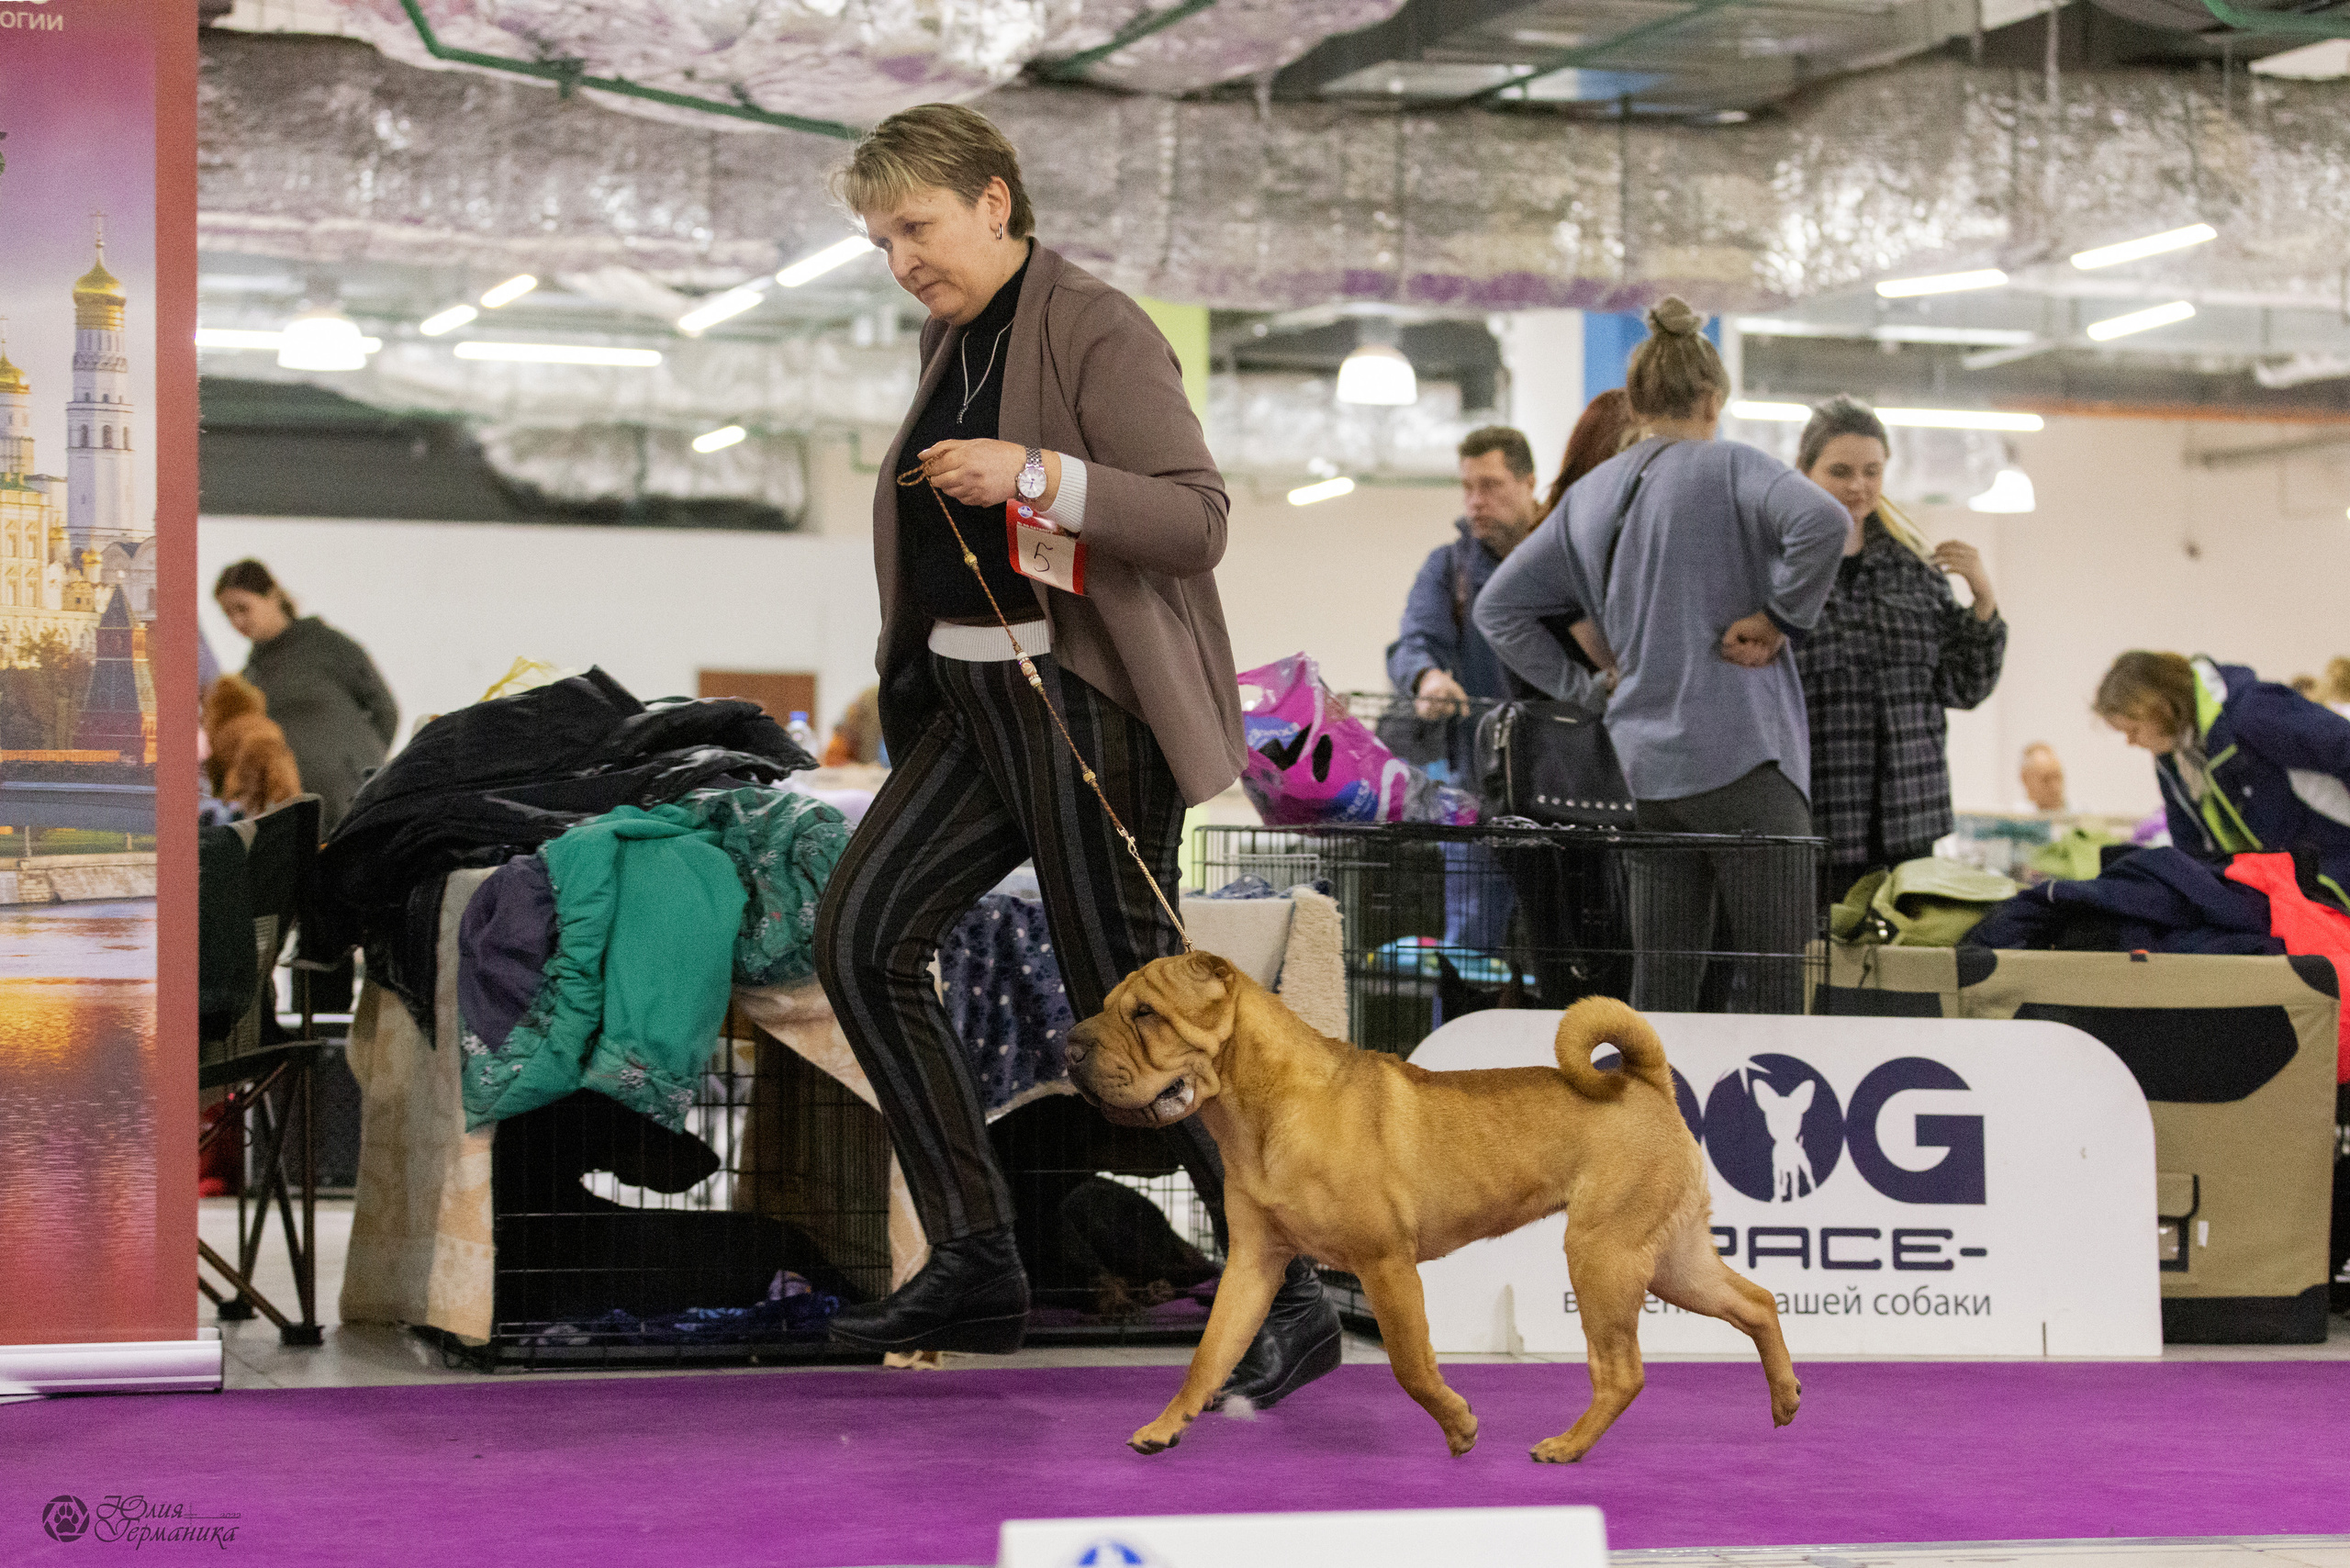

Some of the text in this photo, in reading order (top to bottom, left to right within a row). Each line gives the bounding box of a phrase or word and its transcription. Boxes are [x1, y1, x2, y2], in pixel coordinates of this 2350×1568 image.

[1033, 542, 1054, 573] 5
[1593, 1052, 1986, 1205] OG
[1709, 1226, 1988, 1271] PACE-
[1775, 1284, 1991, 1316] ашей собаки
